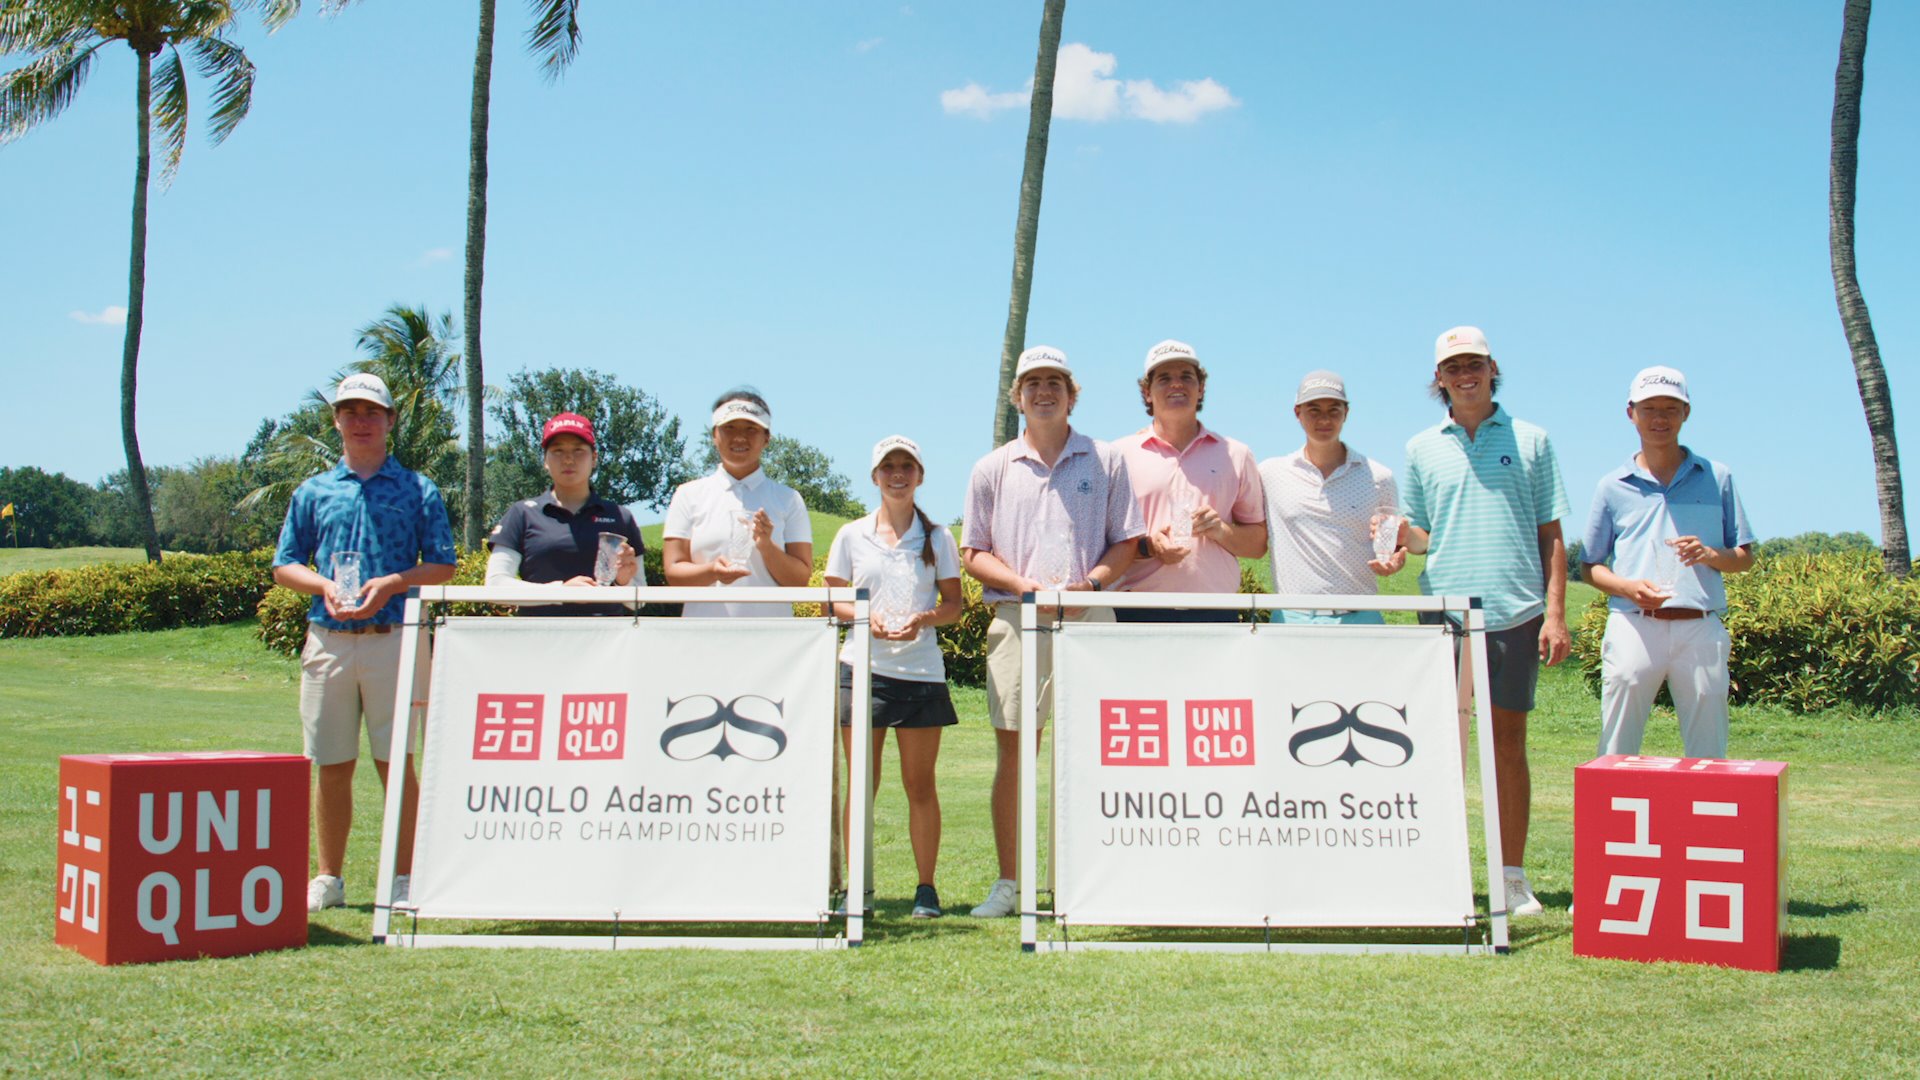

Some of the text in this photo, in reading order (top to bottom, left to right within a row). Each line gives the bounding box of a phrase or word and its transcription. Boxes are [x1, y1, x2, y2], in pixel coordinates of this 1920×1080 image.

[566, 701, 616, 725] UNI
[1192, 707, 1241, 731] UNI
[565, 729, 619, 756] QLO
[1193, 735, 1248, 762] QLO
[466, 785, 786, 817] UNIQLO Adam Scott
[1101, 791, 1419, 823] UNIQLO Adam Scott
[138, 789, 271, 855] UNI
[464, 820, 785, 842] JUNIOR CHAMPIONSHIP
[1101, 827, 1421, 847] JUNIOR CHAMPIONSHIP
[137, 865, 283, 945] QLO
